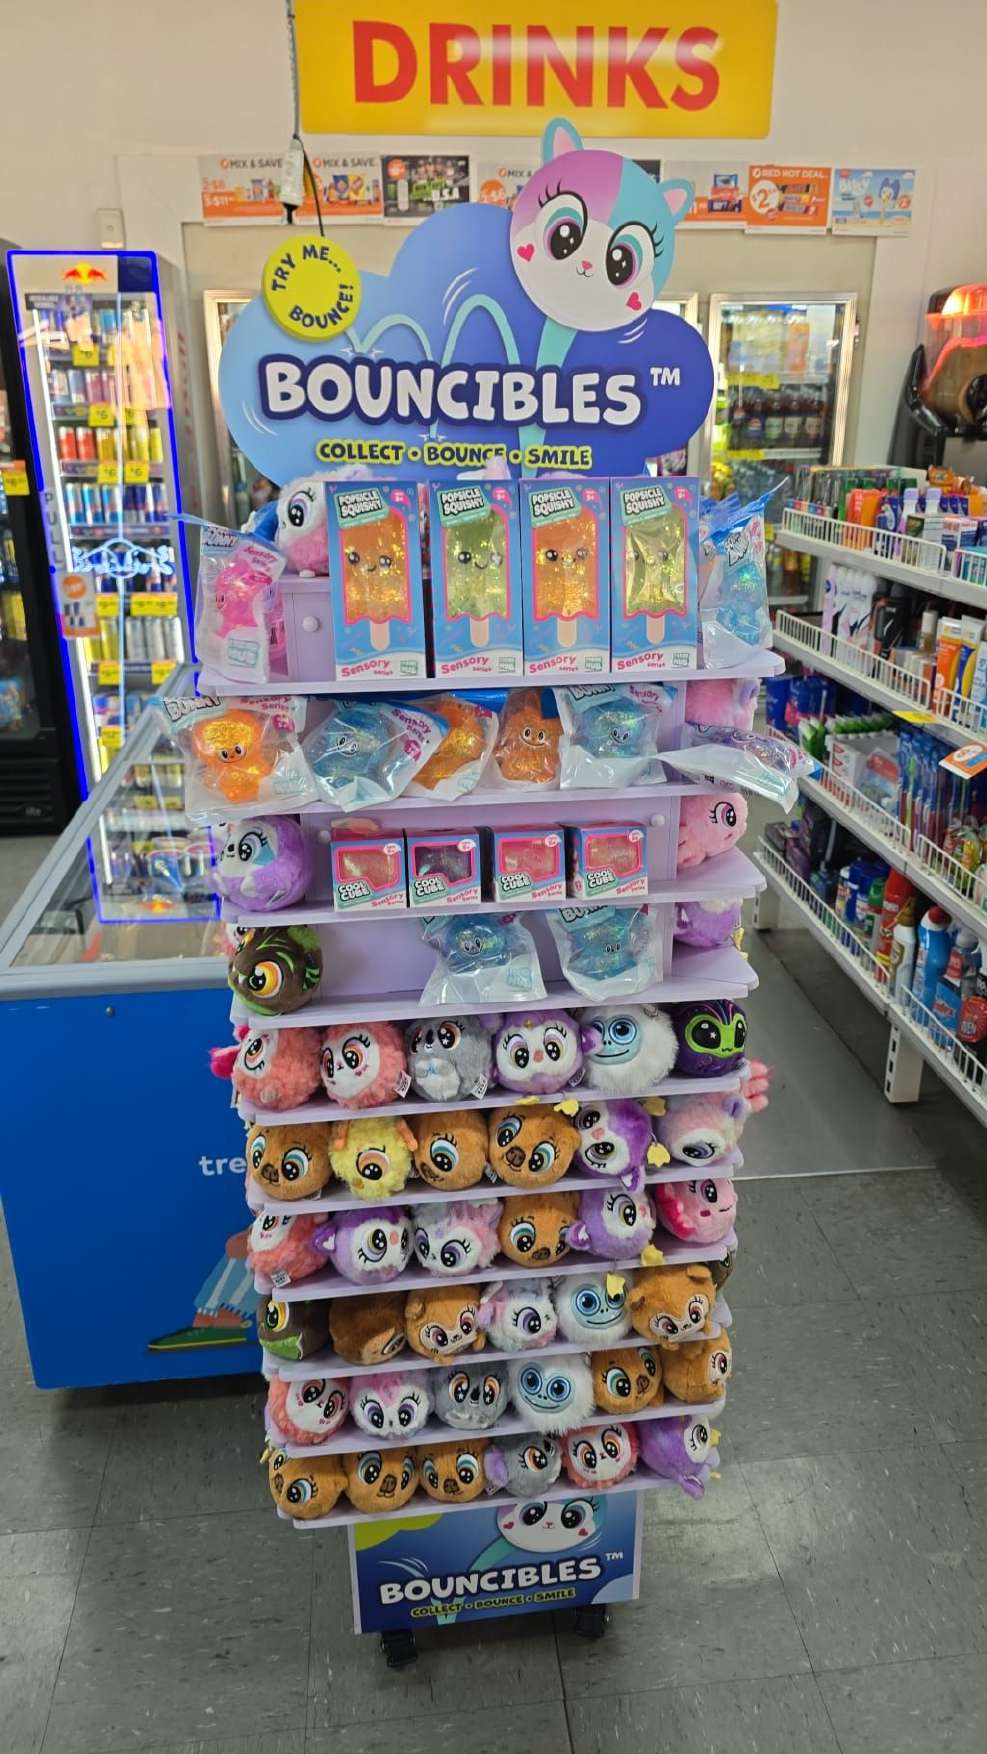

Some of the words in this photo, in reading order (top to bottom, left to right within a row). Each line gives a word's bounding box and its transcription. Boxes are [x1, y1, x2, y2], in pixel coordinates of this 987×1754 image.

[352, 20, 722, 112] DRINKS
[258, 159, 283, 169] SAVE
[352, 158, 376, 167] SAVE
[762, 168, 781, 177] RED
[782, 168, 801, 177] HOT
[271, 252, 296, 291] TRY
[289, 283, 354, 329] BOUNCE!
[265, 361, 641, 426] BOUNCIBLES
[319, 443, 404, 461] COLLECT
[528, 448, 591, 466] SMILE
[532, 488, 572, 504] POPSICLE
[624, 487, 662, 503] POPSICLE
[534, 499, 574, 515] SQUISHY
[626, 497, 664, 514] SQUISHY
[341, 659, 391, 677] Sensory
[441, 656, 489, 674] Sensory
[529, 655, 577, 673] Sensory
[617, 652, 663, 670] Sensory
[414, 877, 441, 889] COOL
[501, 871, 527, 883] COOL
[588, 869, 612, 881] COOL
[339, 880, 366, 893] COOL
[379, 1557, 602, 1605] BOUNCIBLES
[411, 1602, 462, 1616] COLLECT
[475, 1595, 524, 1609] BOUNCE
[535, 1588, 575, 1601] SMILE
